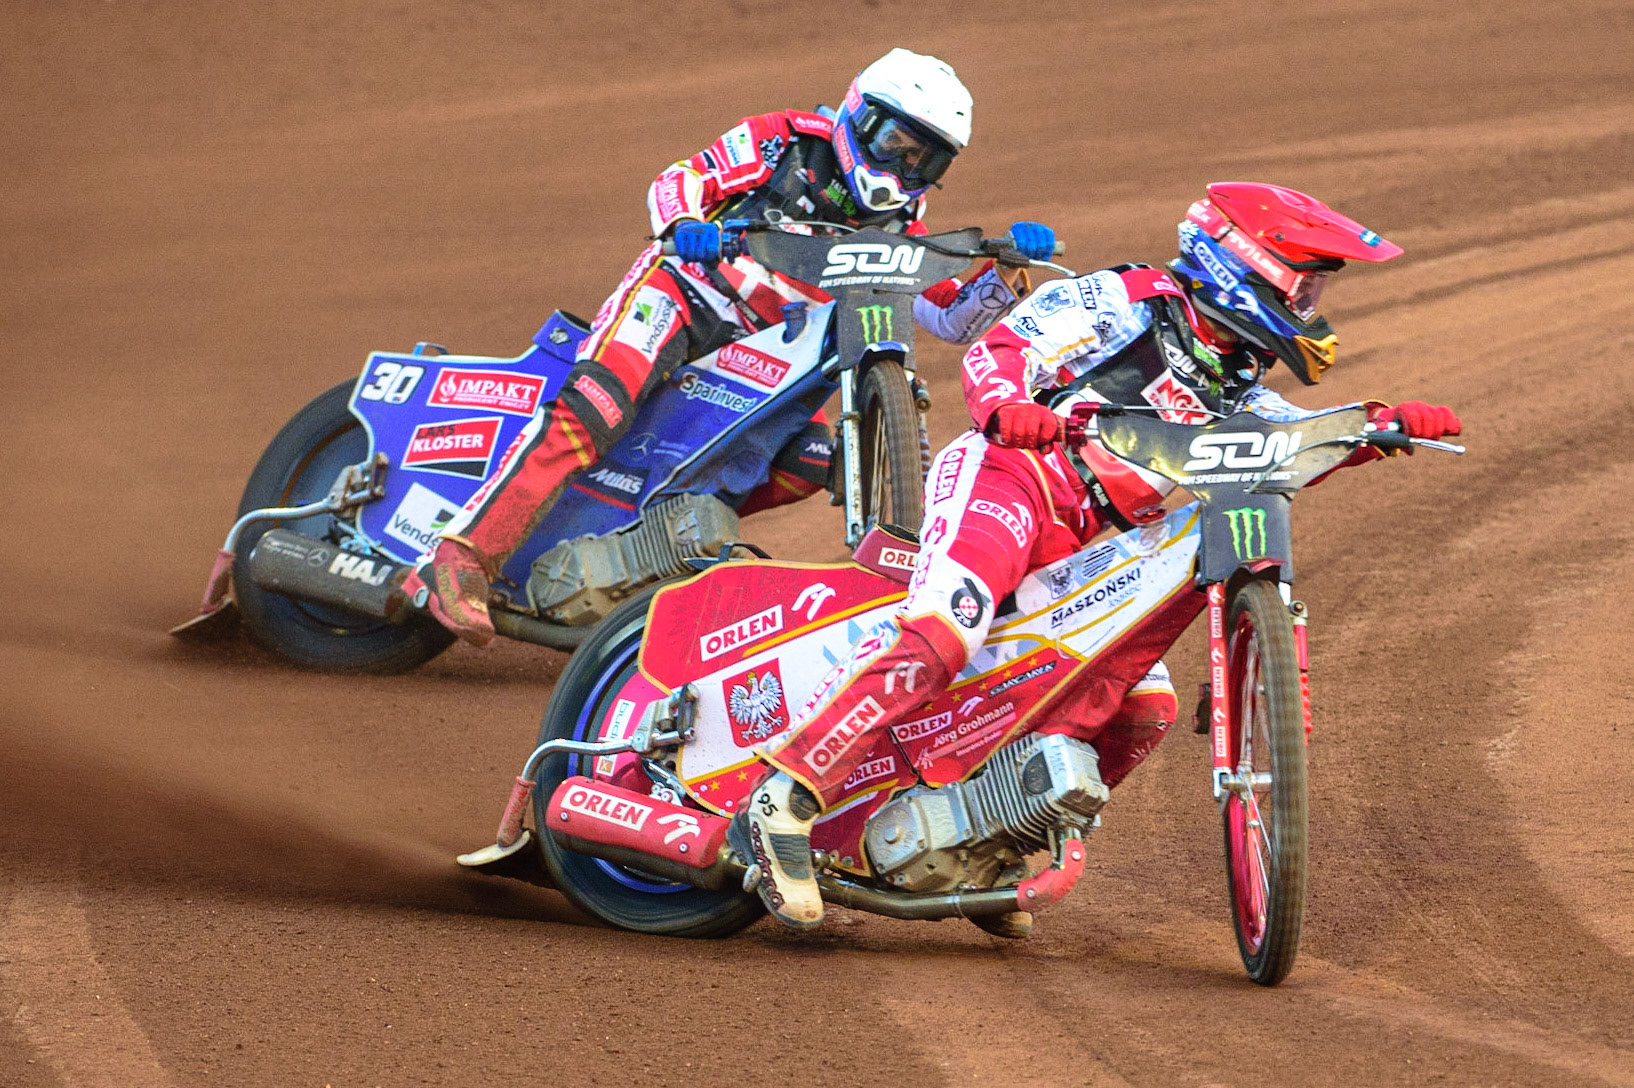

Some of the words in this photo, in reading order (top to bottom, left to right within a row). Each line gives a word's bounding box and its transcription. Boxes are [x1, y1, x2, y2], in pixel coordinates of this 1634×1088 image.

[730, 346, 786, 378] IMPAKT
[360, 361, 426, 405] 30
[457, 378, 537, 400] IMPAKT
[1156, 377, 1206, 425] NGK
[412, 434, 484, 453] KLOSTER
[415, 425, 456, 439] LARS
[935, 449, 965, 504] ORLEN
[884, 551, 918, 568] ORL
[706, 611, 776, 654] ORLEN
[813, 702, 880, 768] ORLEN
[895, 715, 949, 741] ORLEN
[957, 702, 1014, 736] Grohmann
[569, 790, 645, 825] ORLEN
[757, 792, 779, 817] 95
